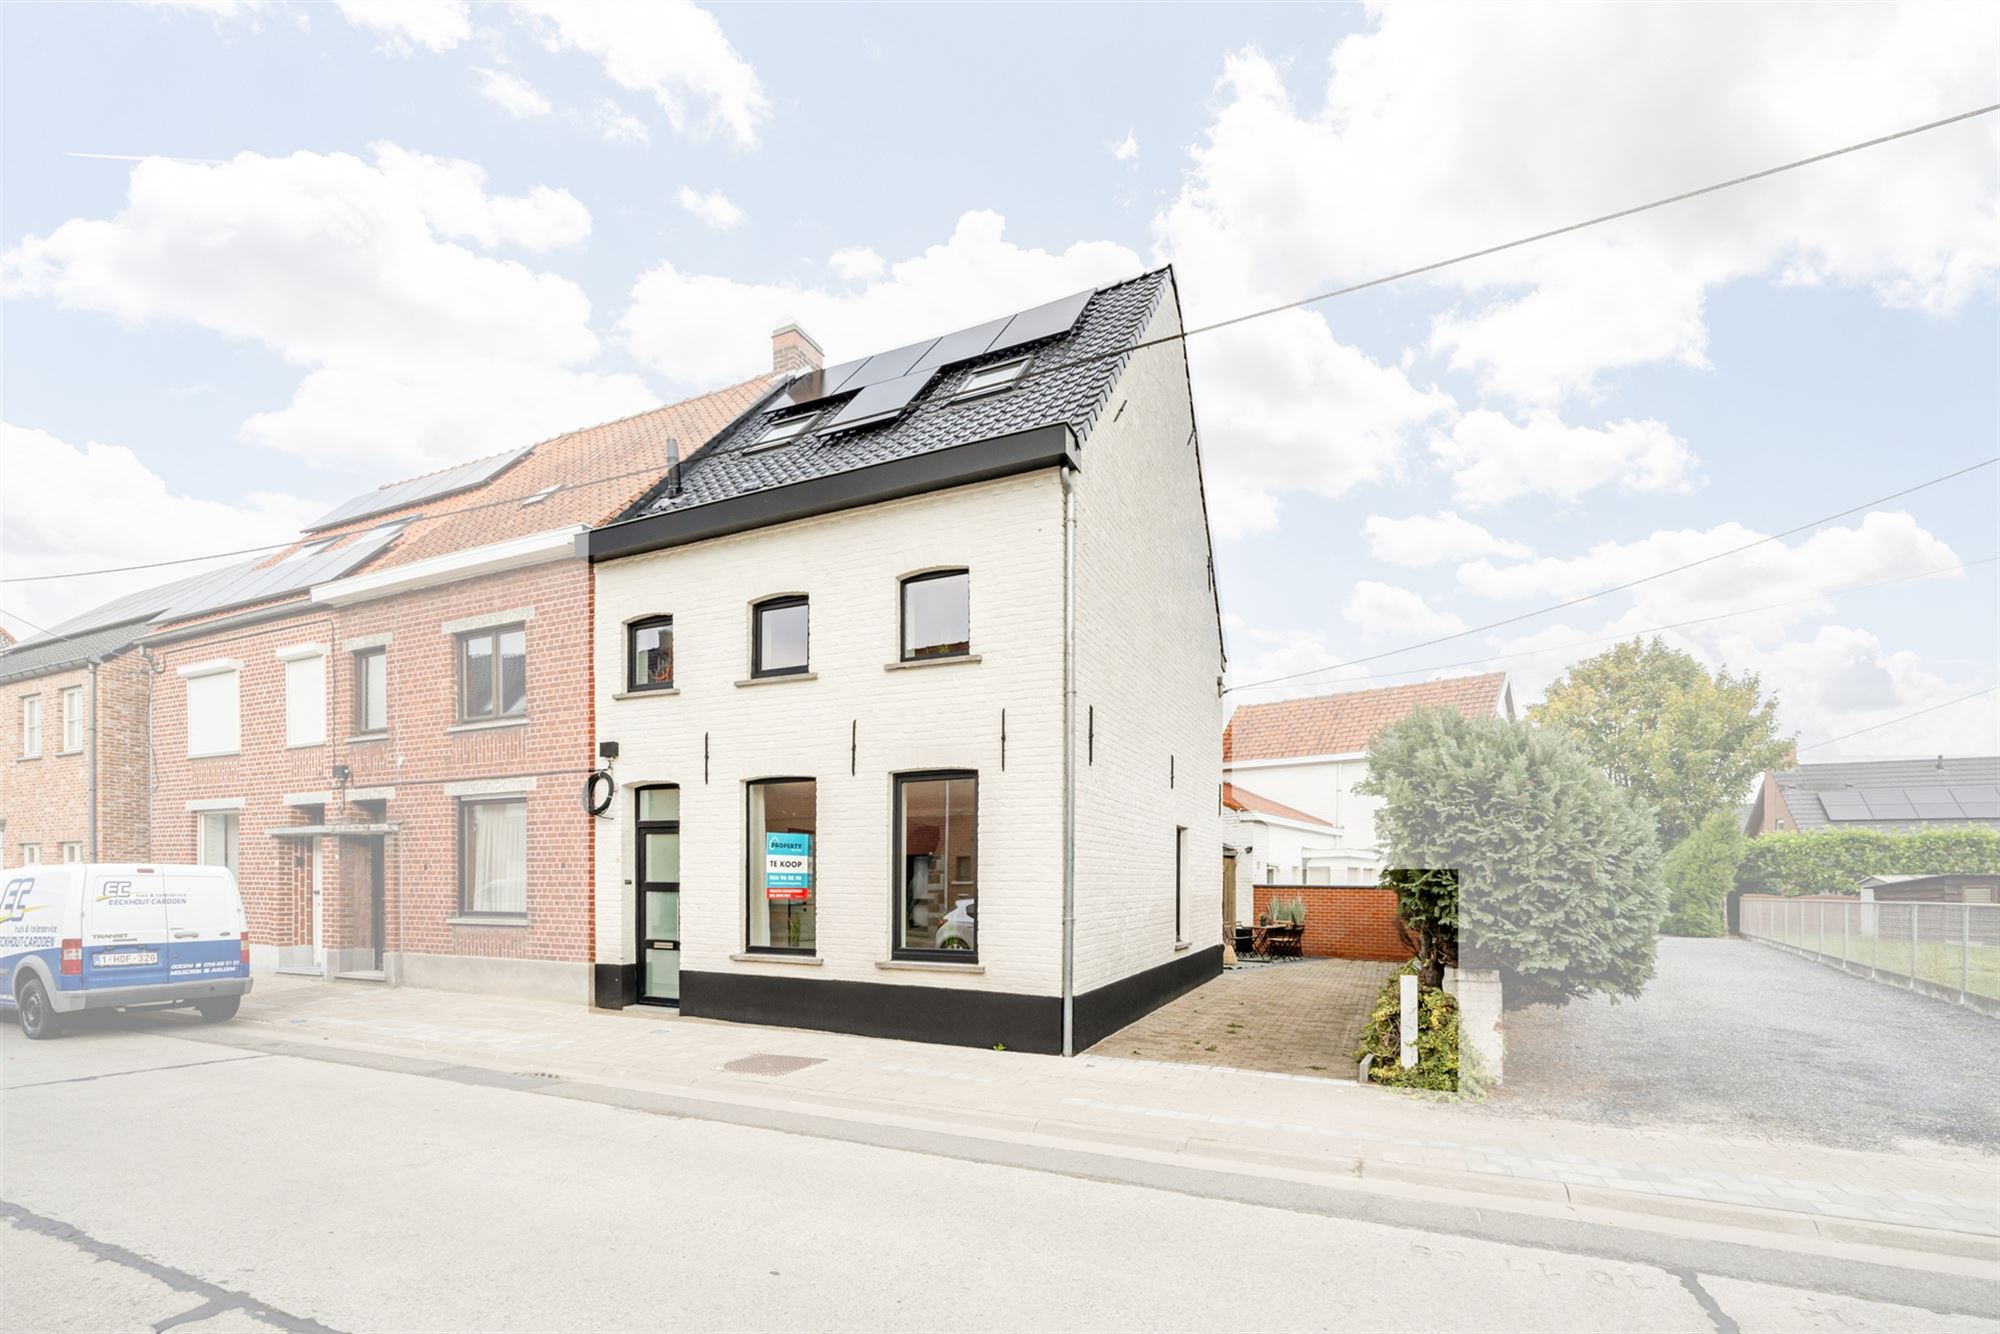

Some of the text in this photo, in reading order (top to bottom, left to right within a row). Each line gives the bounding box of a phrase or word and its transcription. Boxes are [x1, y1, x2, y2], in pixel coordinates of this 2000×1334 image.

[769, 860, 802, 868] TE KOOP
[103, 881, 132, 897] EC
